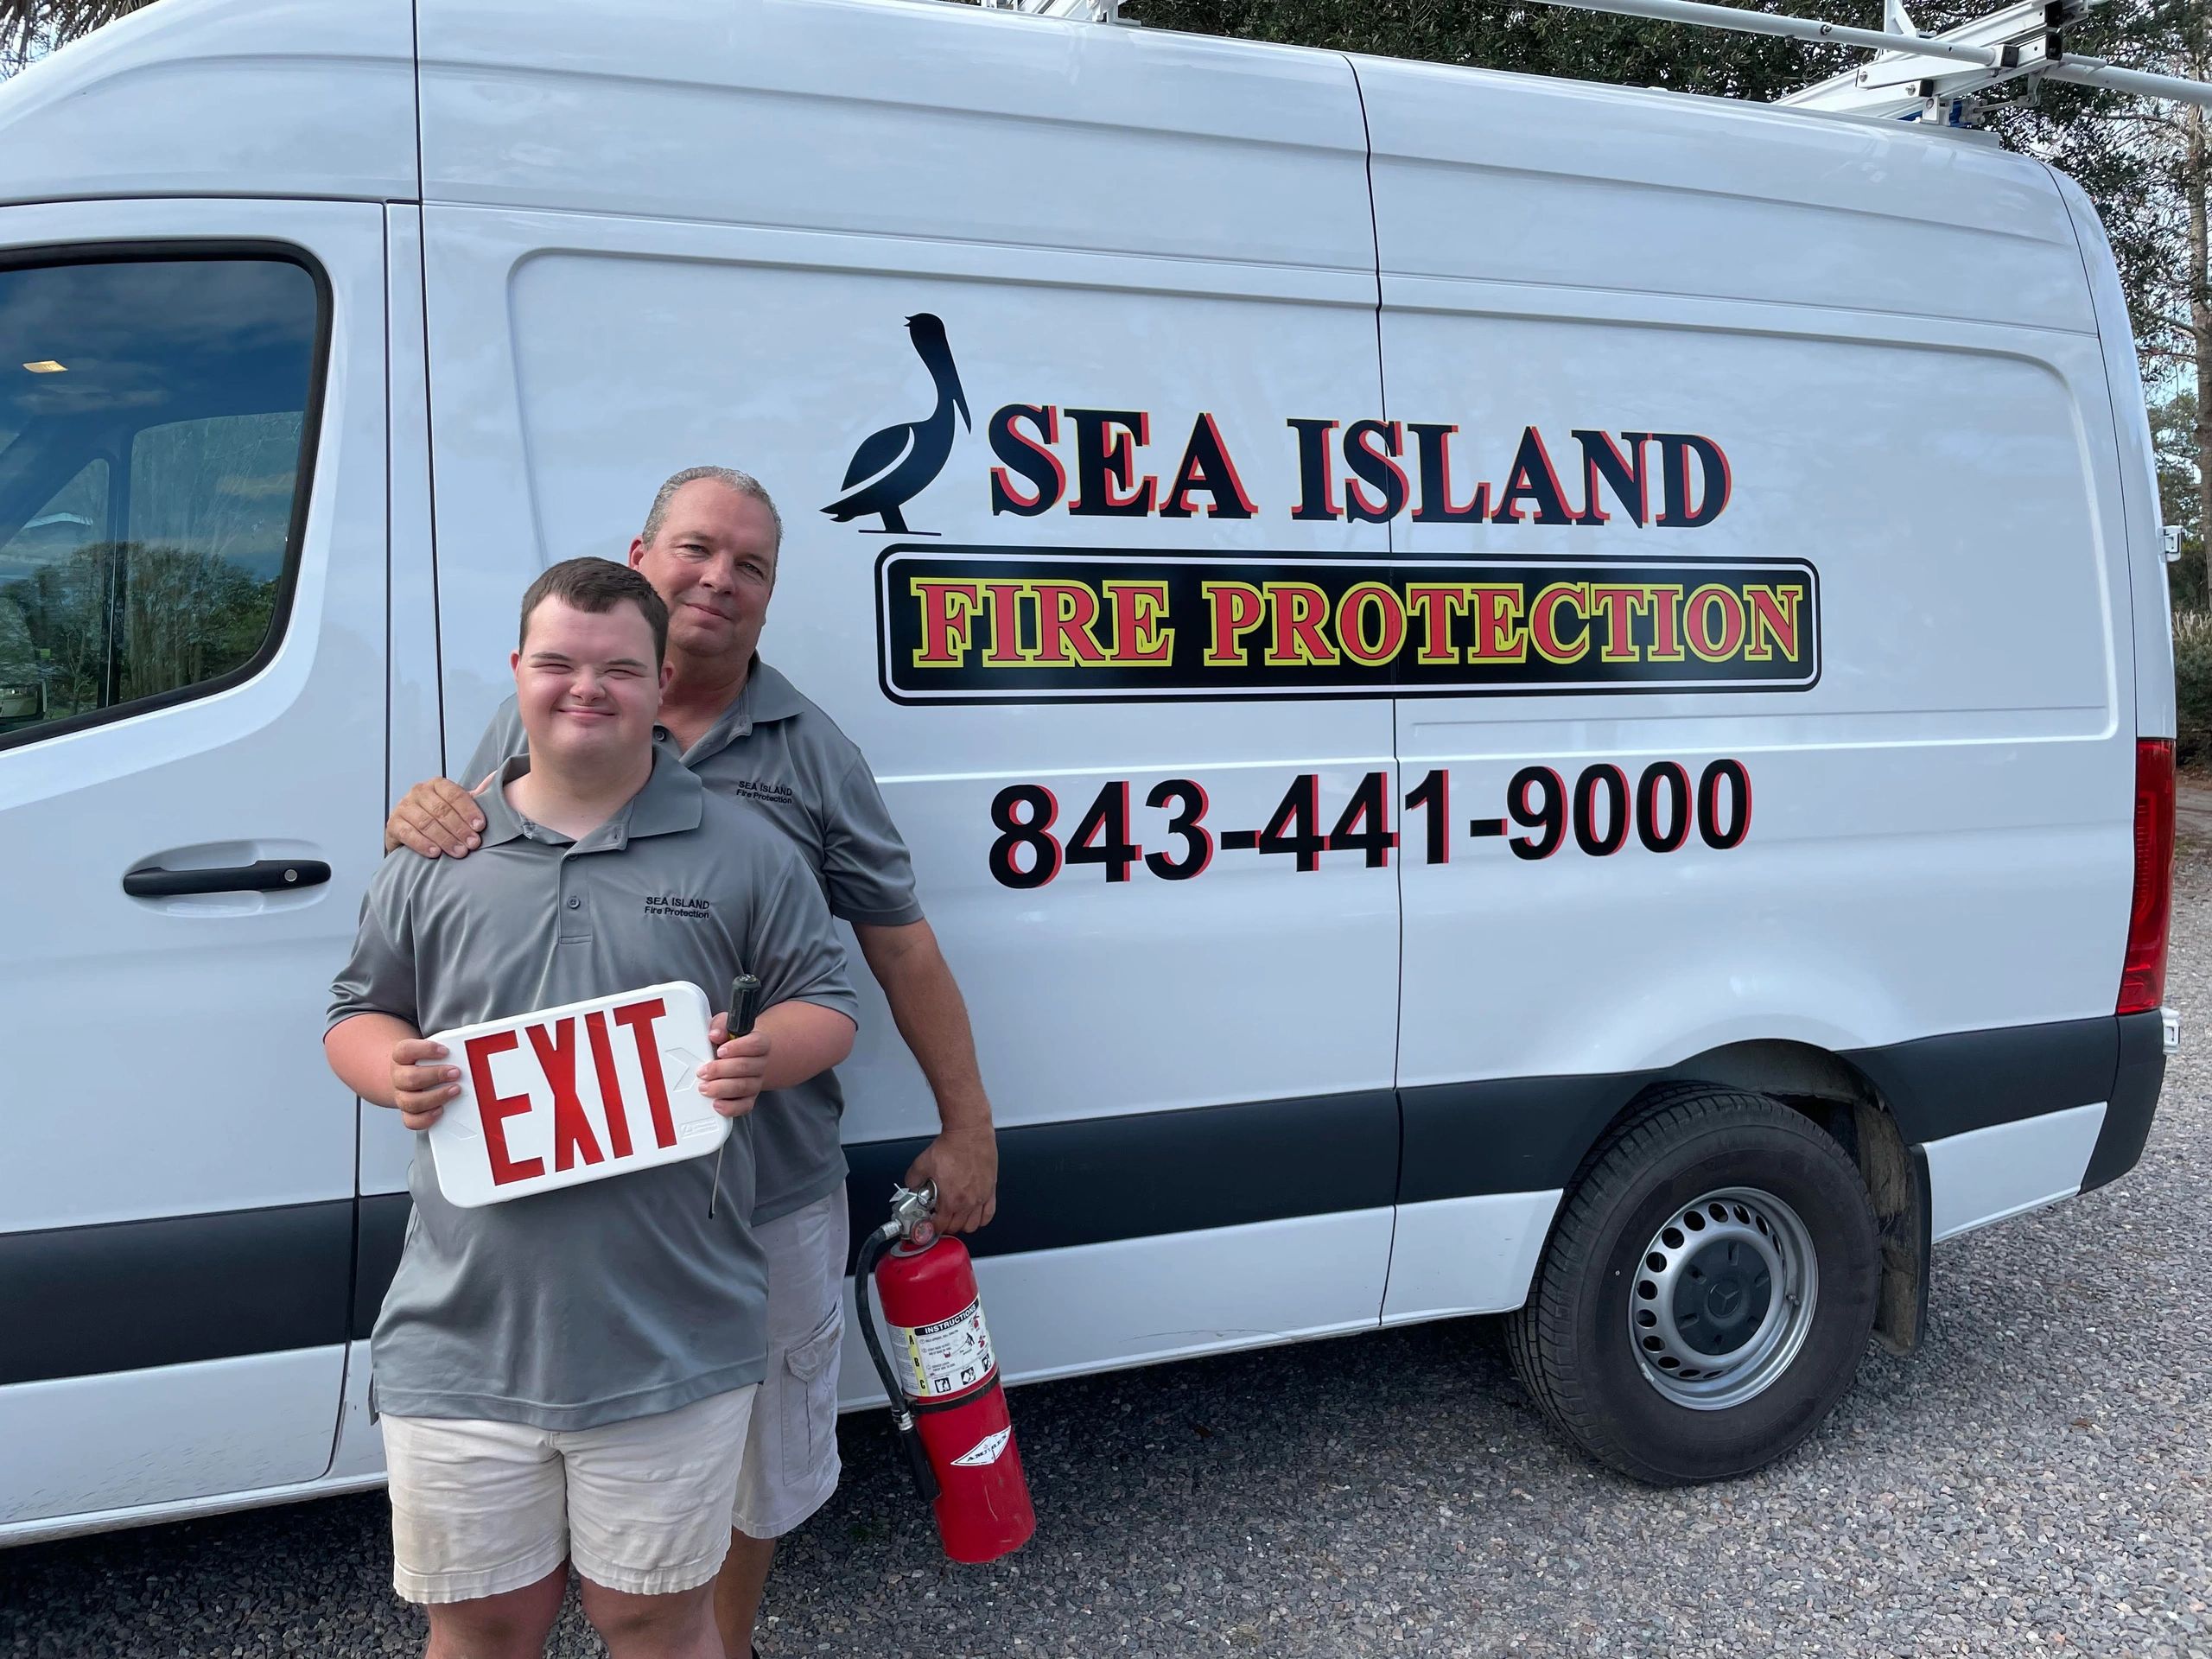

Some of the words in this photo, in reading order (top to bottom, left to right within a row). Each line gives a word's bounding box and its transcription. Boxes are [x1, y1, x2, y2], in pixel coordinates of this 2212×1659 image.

[988, 404, 1258, 519] SEA
[1287, 418, 1732, 529] ISLAND
[910, 577, 1175, 668] FIRE
[1202, 580, 1802, 667] PROTECTION
[736, 788, 753, 798] Fire
[753, 791, 793, 804] Protection
[739, 780, 758, 791] SEA
[760, 783, 793, 797] ISLAND
[988, 759, 1752, 889] 843-441-9000
[645, 896, 669, 906] SEA
[671, 897, 710, 910] ISLAND
[645, 906, 663, 915] Fire
[664, 906, 710, 919] Protection
[464, 997, 678, 1186] EXIT
[925, 1304, 976, 1334] INSTRUCTIONS
[908, 1334, 915, 1345] A
[913, 1357, 920, 1367] B
[919, 1379, 926, 1389] C
